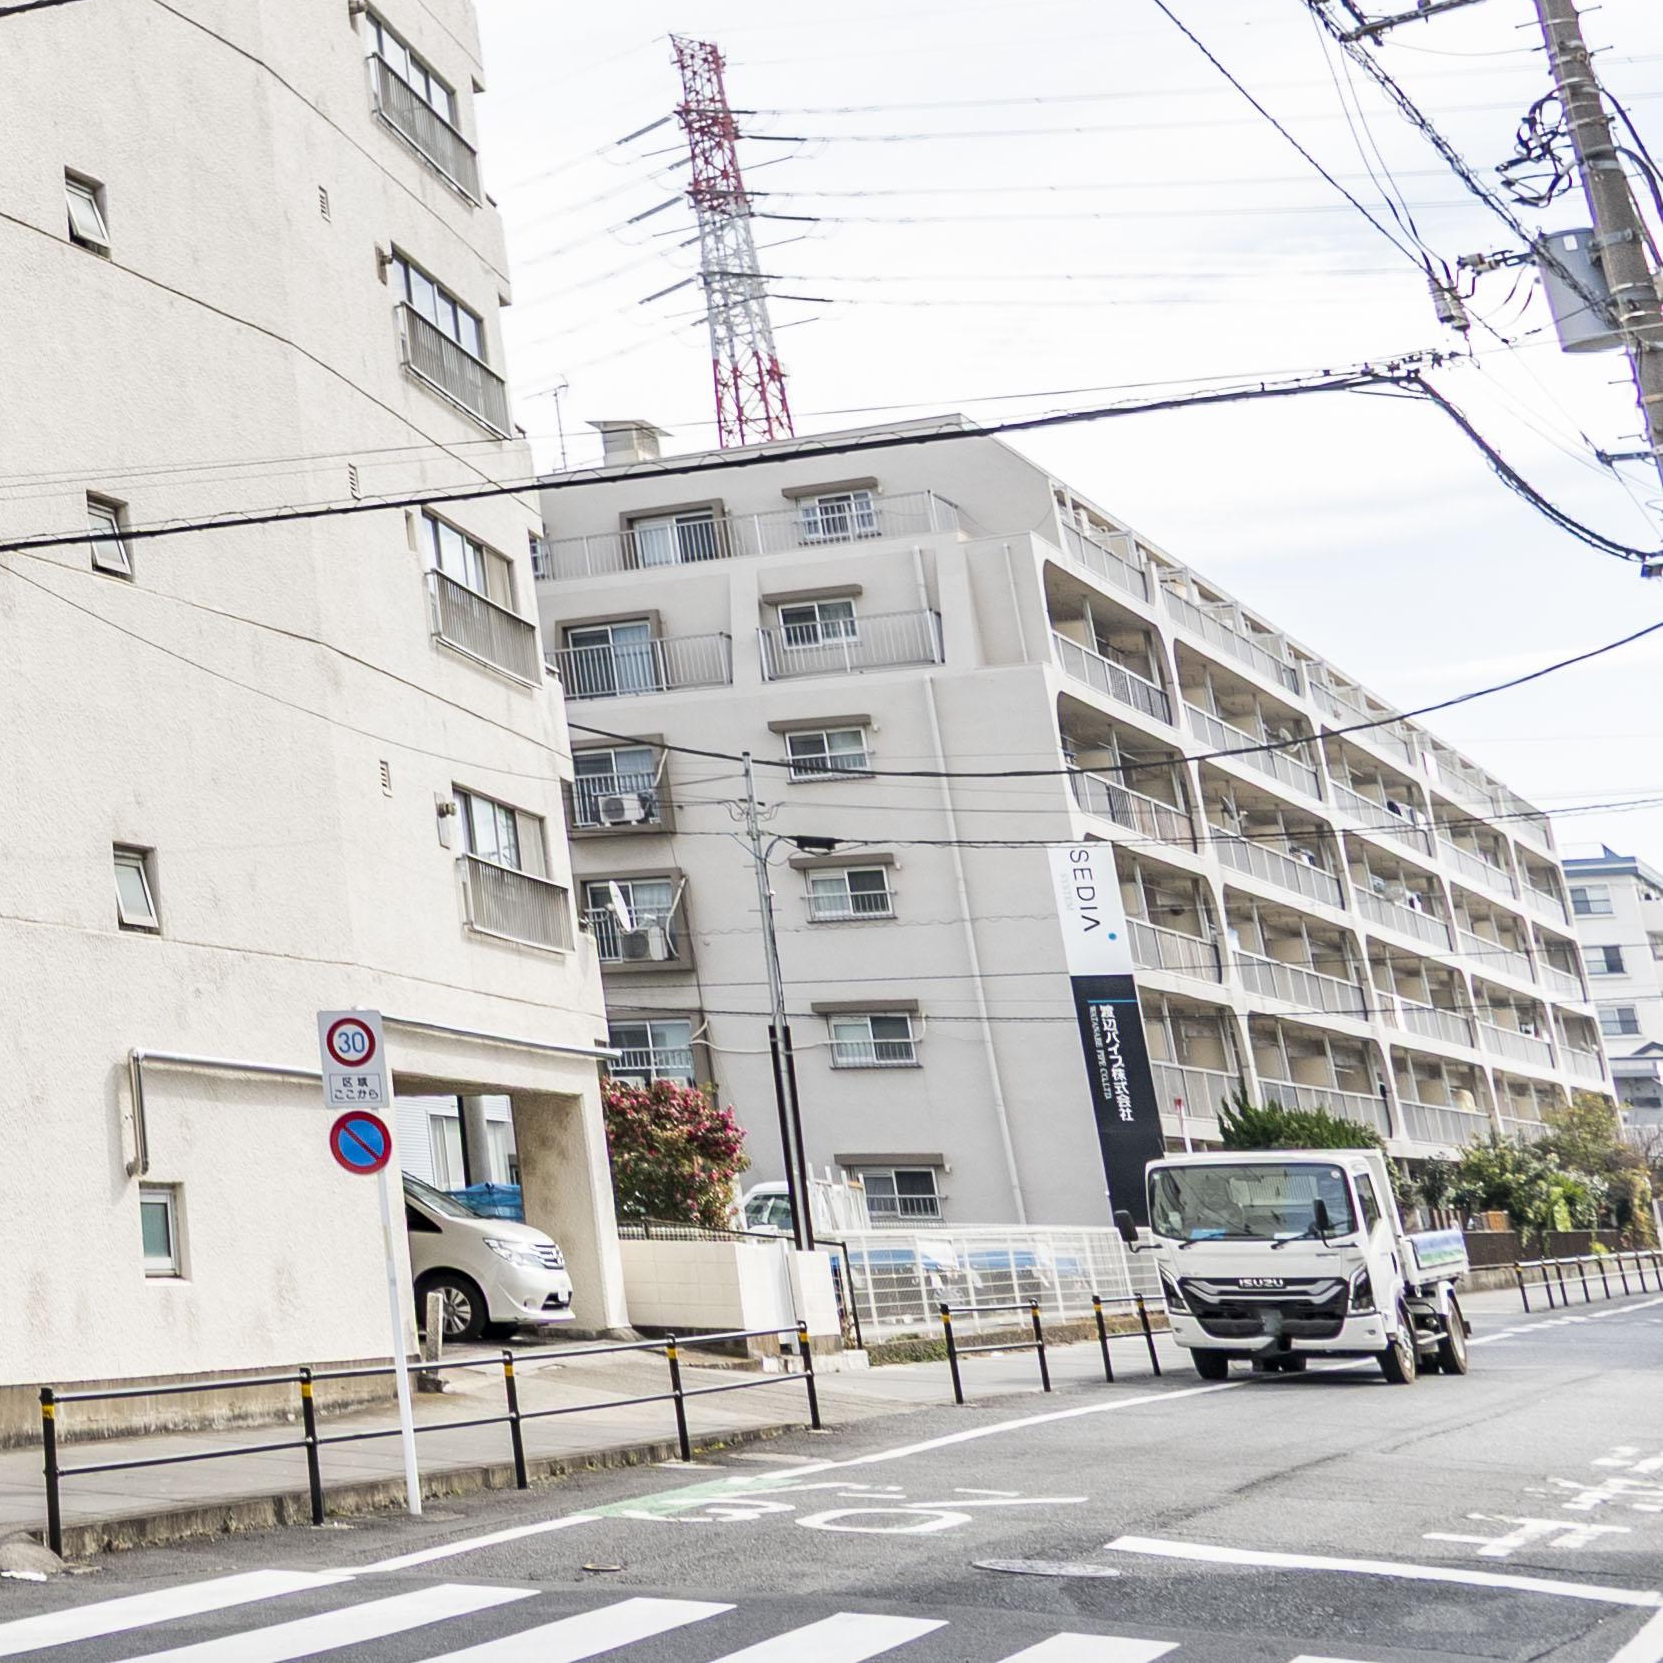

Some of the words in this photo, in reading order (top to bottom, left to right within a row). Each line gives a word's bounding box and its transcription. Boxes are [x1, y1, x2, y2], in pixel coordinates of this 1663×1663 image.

[1069, 849, 1101, 932] SEDIA
[337, 1031, 366, 1054] 30
[342, 1076, 369, 1088] 区域
[334, 1088, 379, 1100] ここから
[1238, 1278, 1284, 1288] ISUZU
